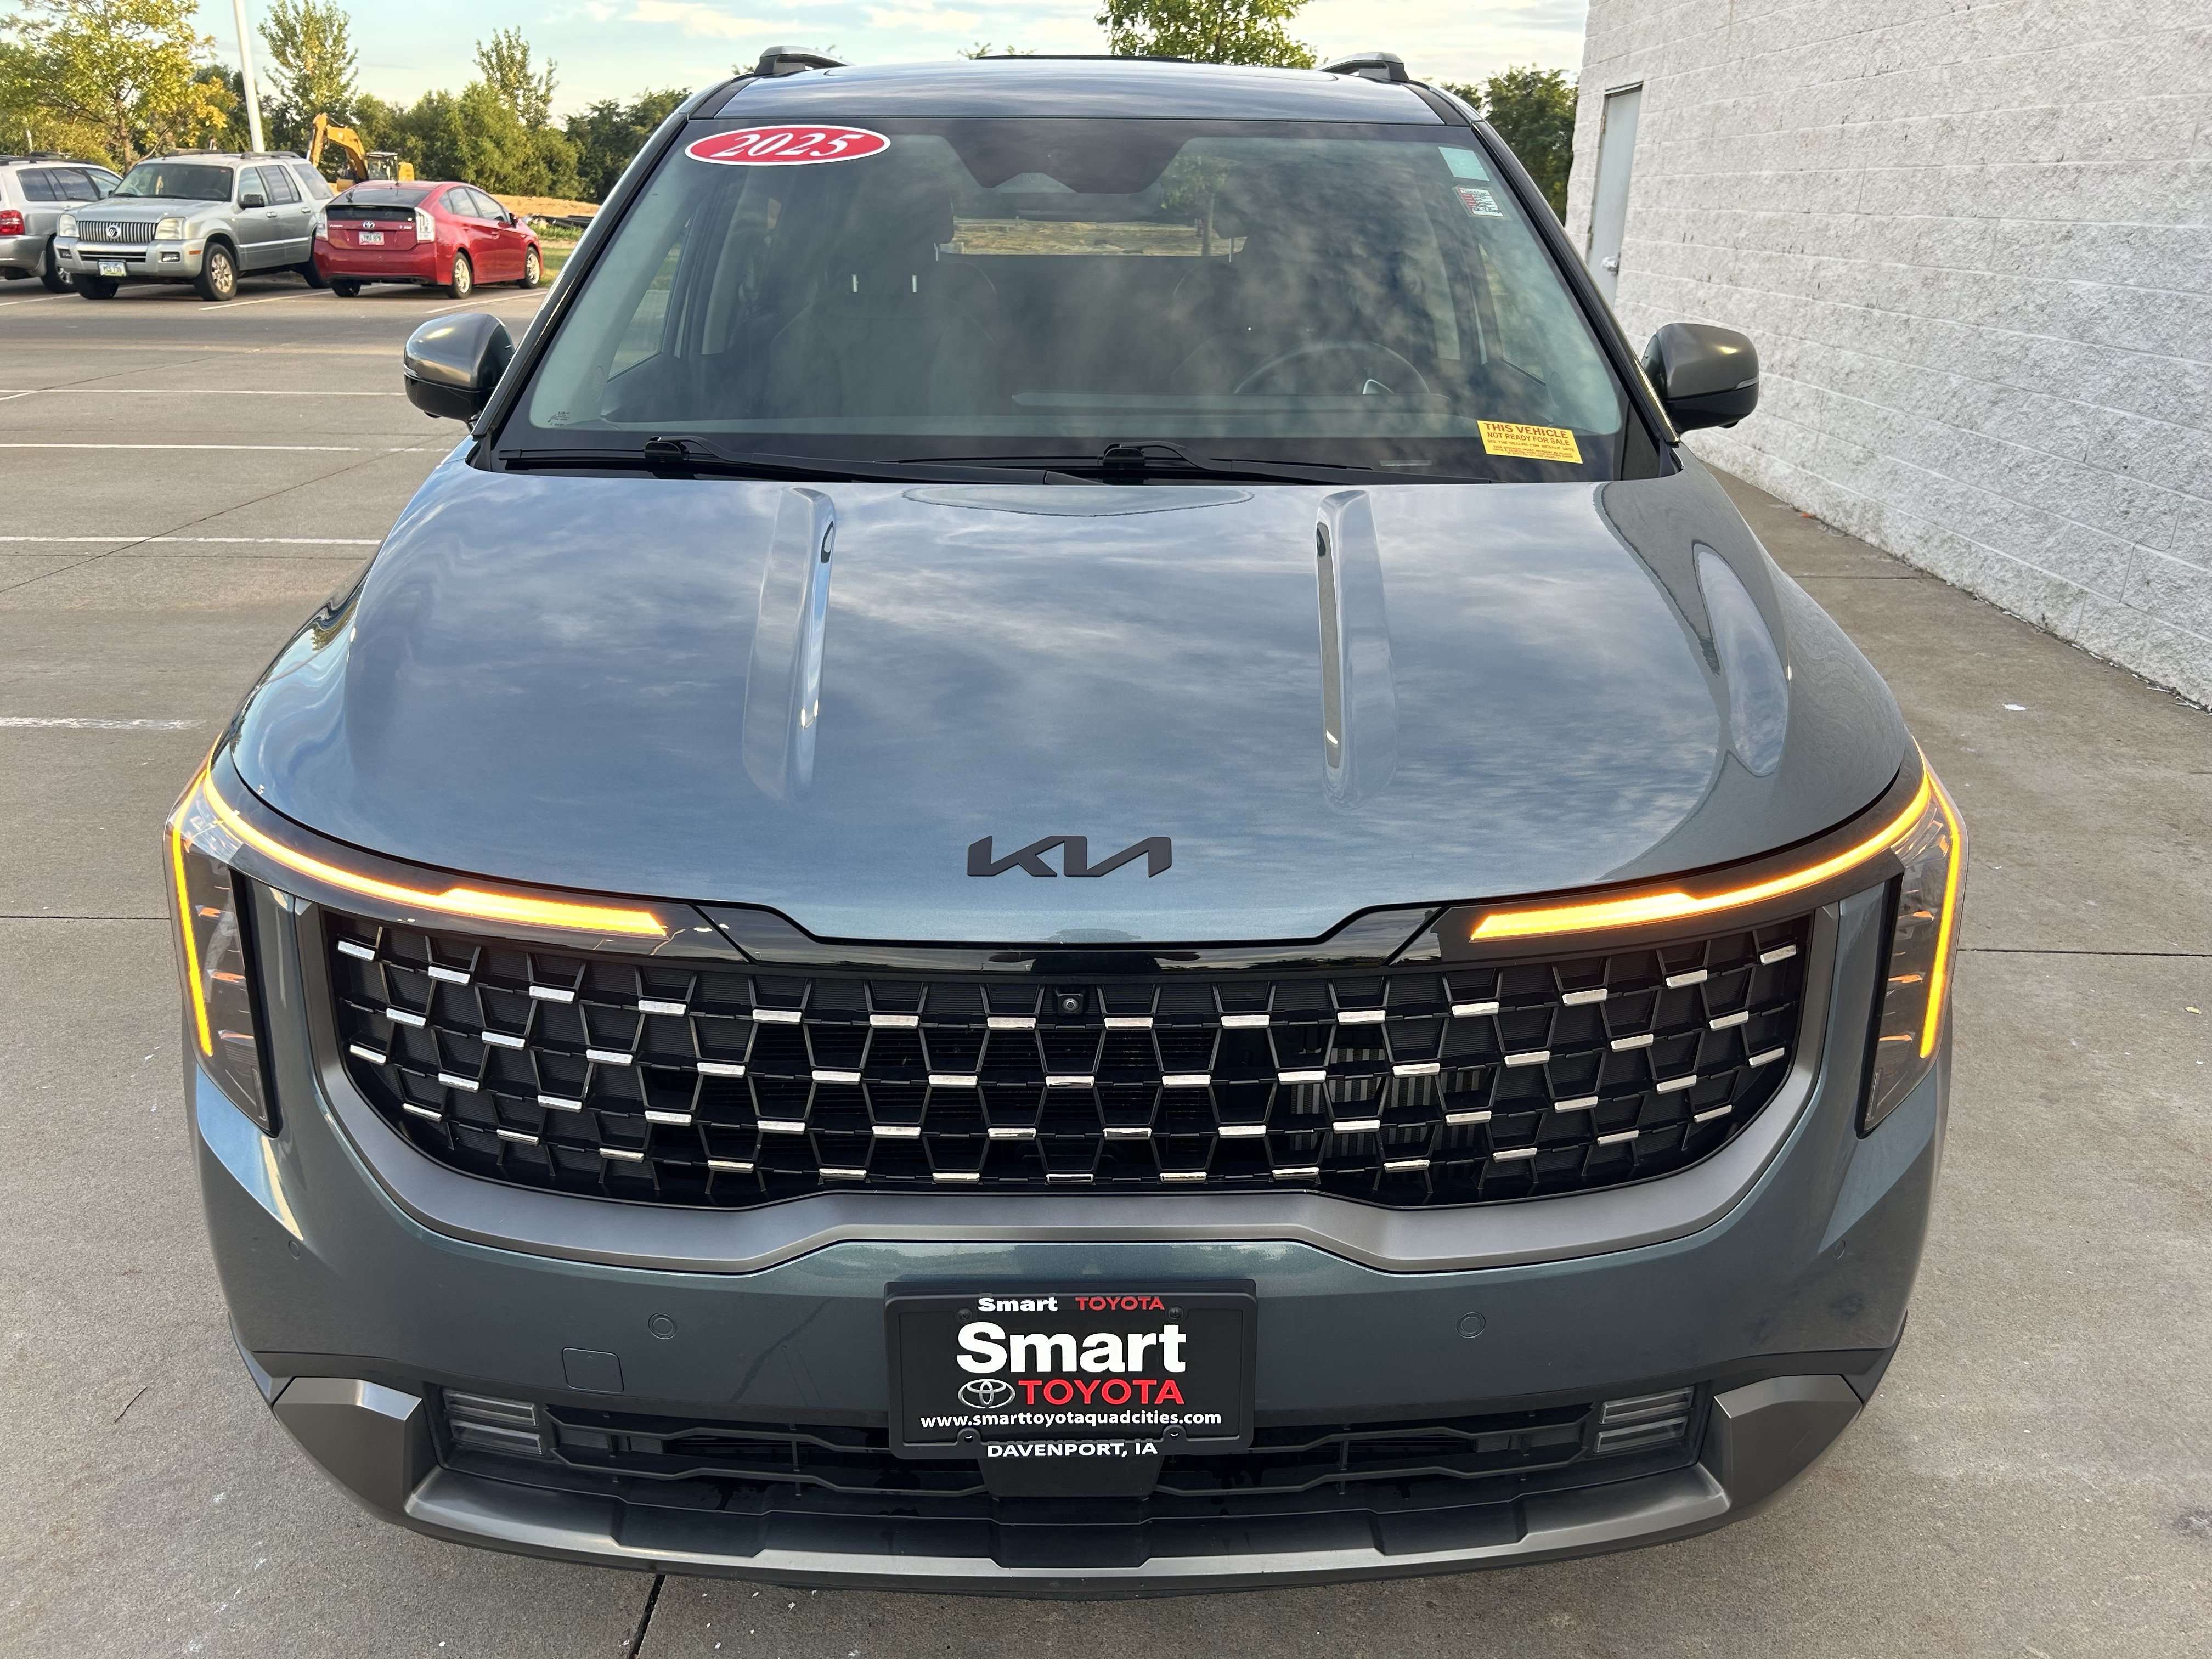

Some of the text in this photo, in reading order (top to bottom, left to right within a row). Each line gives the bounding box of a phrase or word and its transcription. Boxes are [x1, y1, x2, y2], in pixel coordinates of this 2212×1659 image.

[709, 132, 865, 157] 2025
[1483, 423, 1568, 438] THIS VEHICLE
[967, 835, 1172, 878] KIA
[978, 1296, 1165, 1312] Smart TOYOTA
[956, 1322, 1187, 1374] Smart
[1018, 1379, 1185, 1406] TOYOTA
[920, 1410, 1222, 1429] www.smarttoyotaquadcities.com
[987, 1442, 1158, 1458] DAVENPORT, IA
